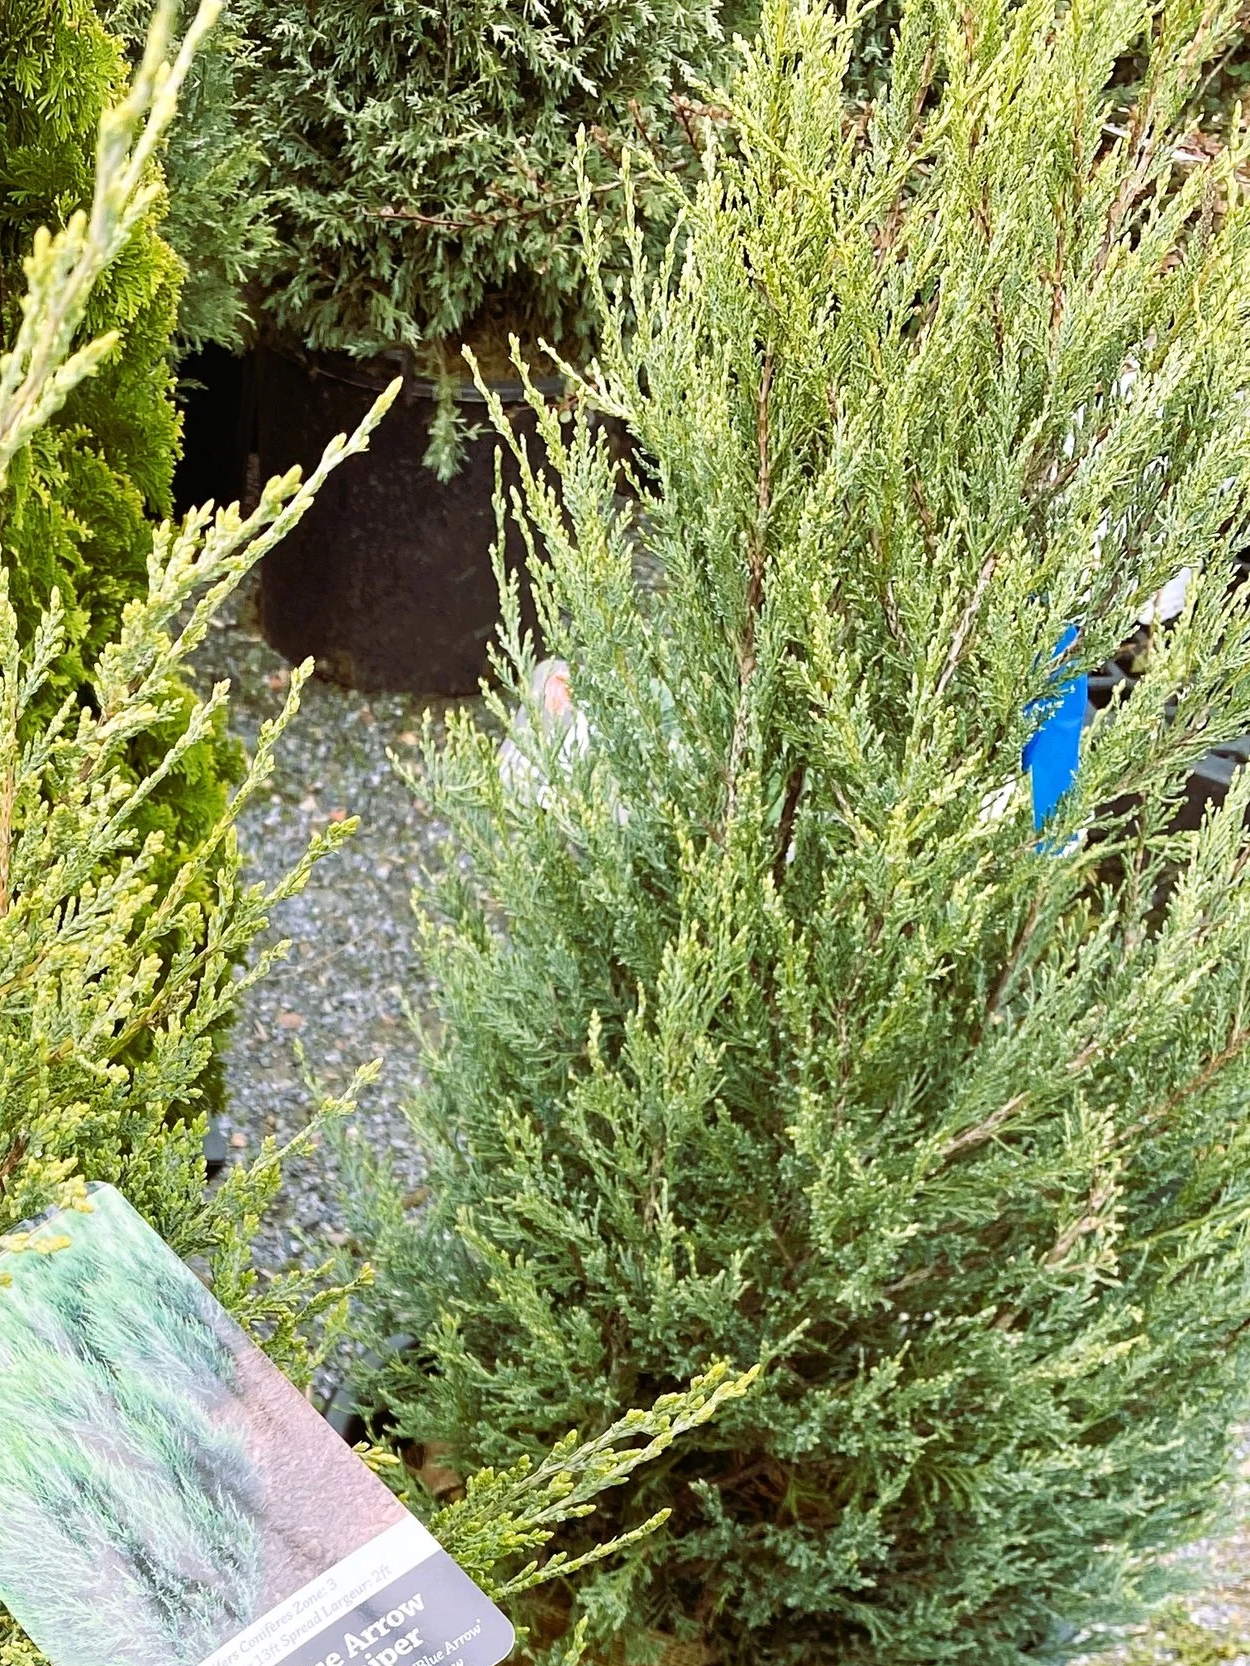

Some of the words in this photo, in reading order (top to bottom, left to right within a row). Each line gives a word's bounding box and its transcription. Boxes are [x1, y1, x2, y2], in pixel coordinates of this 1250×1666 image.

[240, 1612, 293, 1652] Conifères
[293, 1588, 327, 1614] Zone:
[326, 1578, 337, 1590] 3
[254, 1644, 281, 1666] 13ft
[281, 1611, 322, 1646] Spread
[321, 1580, 372, 1617] Largeur:
[372, 1565, 392, 1583] 2ft
[344, 1593, 424, 1658] Arrow
